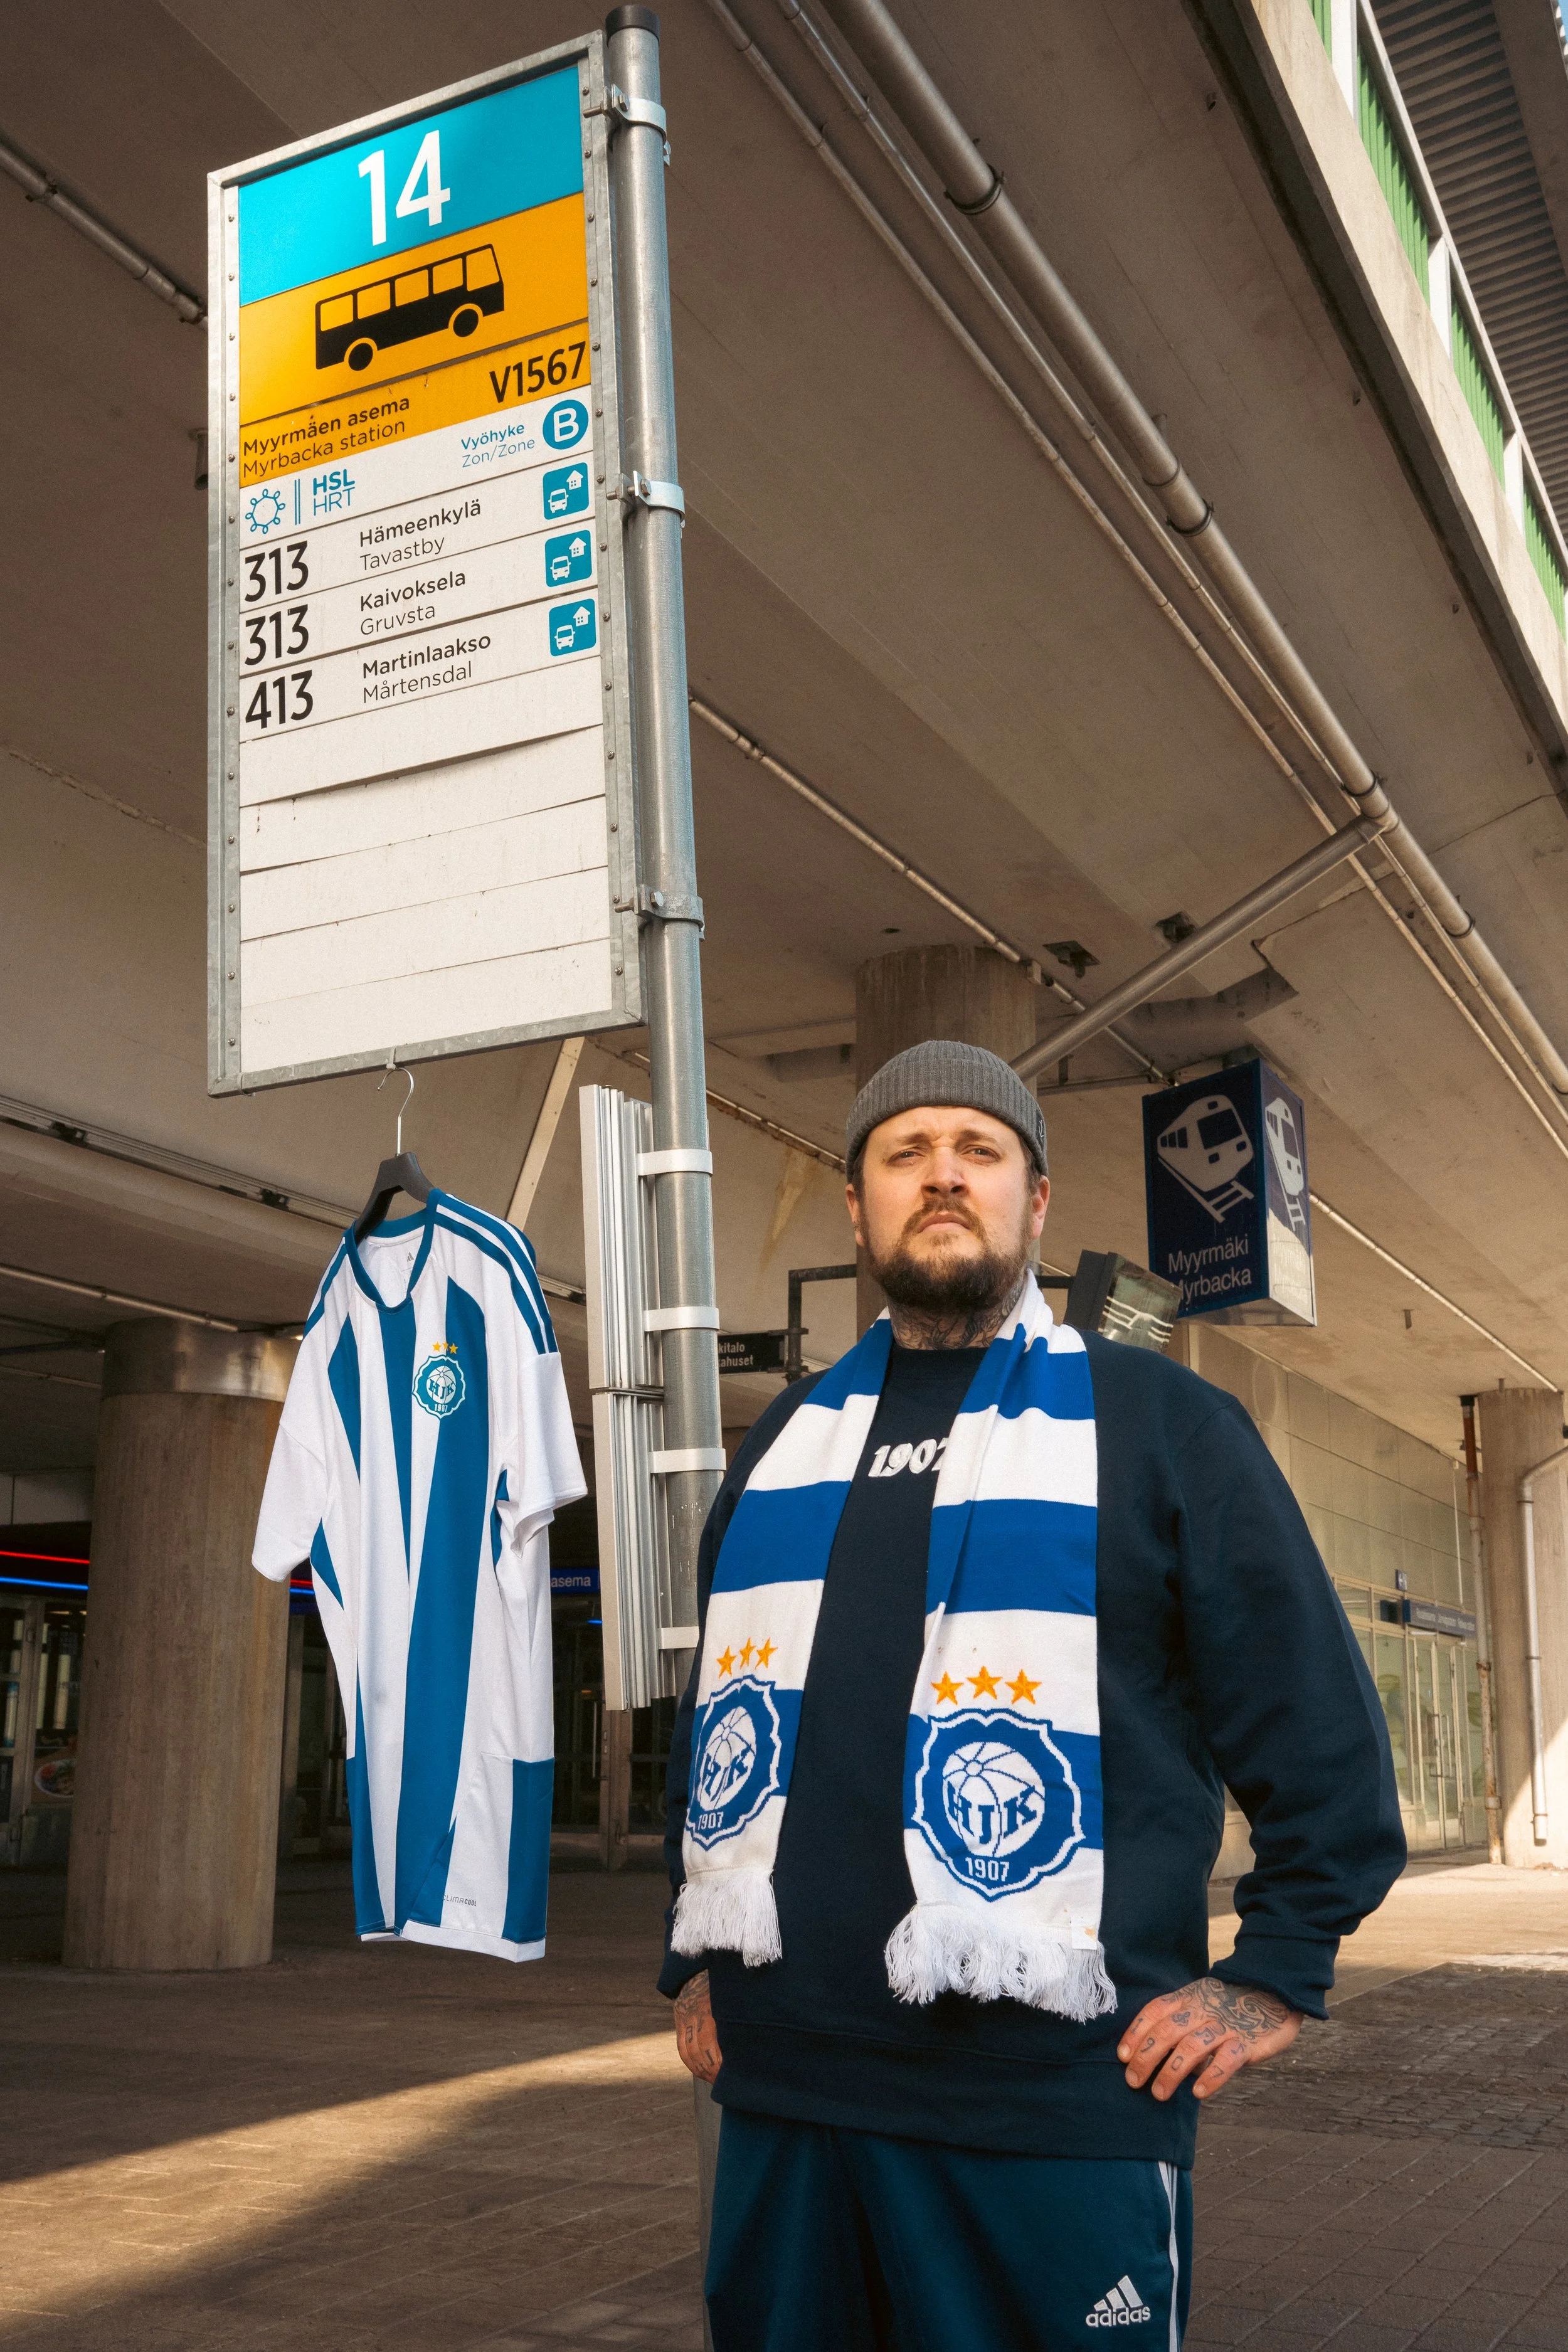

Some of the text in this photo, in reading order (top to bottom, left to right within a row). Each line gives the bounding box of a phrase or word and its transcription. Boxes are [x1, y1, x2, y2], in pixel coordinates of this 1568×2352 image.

[358, 129, 450, 246] 14
[489, 341, 586, 403] V1567
[243, 397, 410, 457] Myyrmäen asema
[461, 423, 526, 450] Vyöhyke
[553, 407, 580, 442] B
[243, 419, 405, 478] Myrbacka station
[462, 438, 536, 469] Zon/Zone
[312, 469, 356, 493] HSL
[313, 488, 356, 517] HRT
[359, 499, 482, 547] Hämeenkylä
[244, 541, 309, 603] 313
[361, 535, 446, 571] Tavastby
[360, 571, 466, 611] Kaivoksela
[244, 604, 309, 666] 313
[360, 605, 437, 636] Gruvsta
[363, 634, 491, 679] Martinlaakso
[245, 669, 314, 729] 413
[363, 660, 473, 704] Mårtensdal
[1168, 1232, 1249, 1276] Myyrmäki
[428, 1378, 455, 1400] HJK
[434, 1404, 448, 1412] 1907
[551, 1576, 591, 1588] asema
[697, 1811, 724, 1831] 1907
[946, 1780, 1038, 1845] HJK
[965, 1856, 1010, 1882] 1907
[1086, 2306, 1151, 2328] adidas
